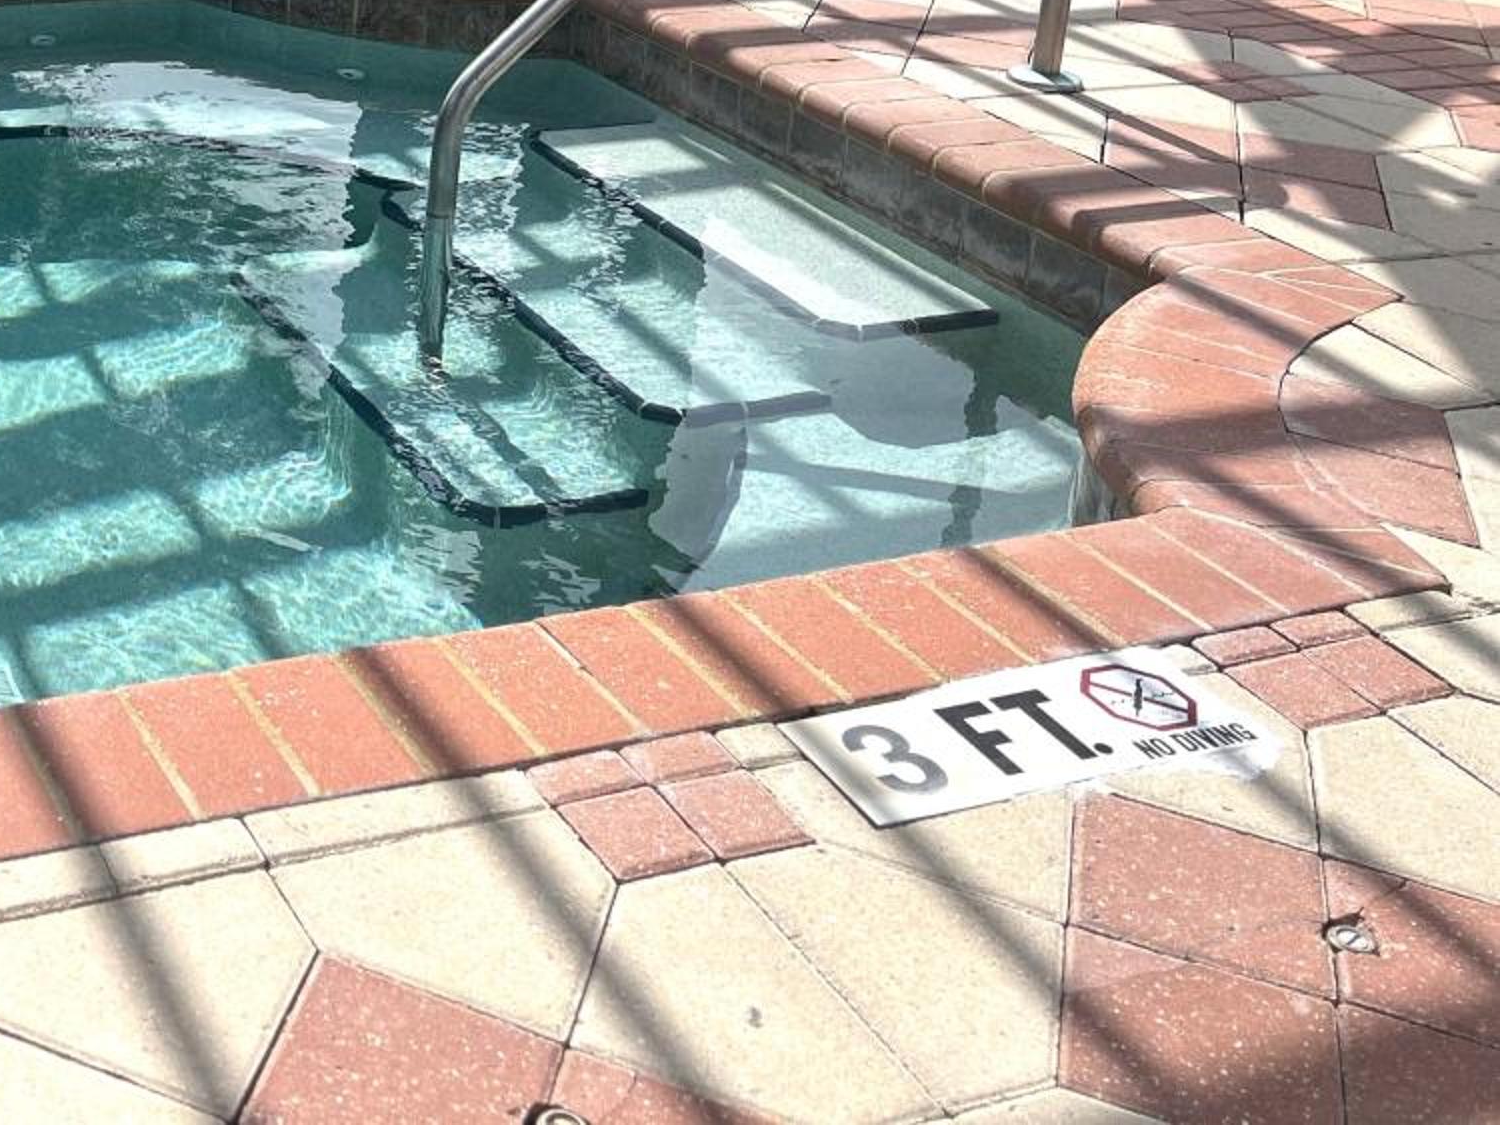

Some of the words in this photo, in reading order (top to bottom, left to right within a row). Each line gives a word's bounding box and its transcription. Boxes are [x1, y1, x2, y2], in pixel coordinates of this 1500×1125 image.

[841, 725, 949, 795] 3
[933, 689, 1114, 776] FT.
[1132, 737, 1177, 760] NO
[1169, 723, 1259, 753] DIVING
